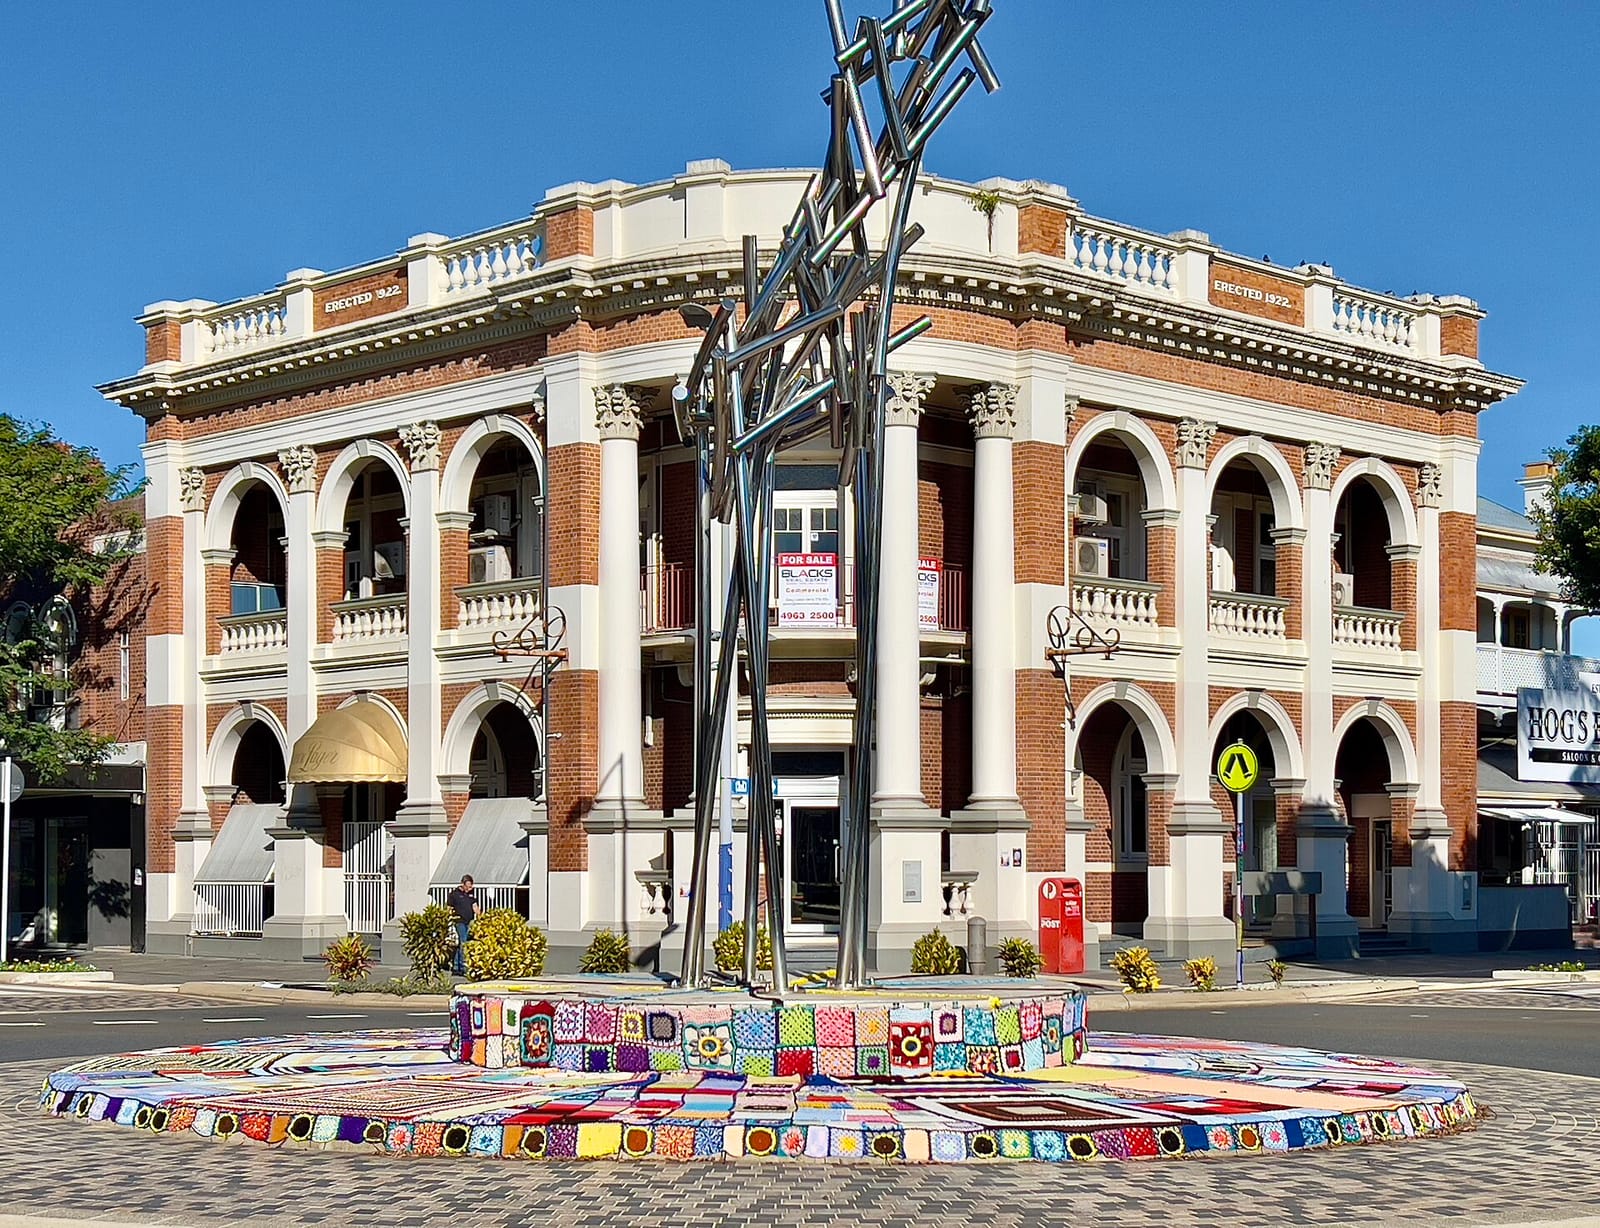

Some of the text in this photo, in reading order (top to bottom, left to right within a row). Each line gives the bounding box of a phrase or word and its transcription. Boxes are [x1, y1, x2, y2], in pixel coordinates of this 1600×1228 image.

[1214, 280, 1262, 300] ERECTED
[325, 292, 372, 312] ERECTED
[782, 555, 833, 564] FOR SALE
[781, 569, 833, 578] BLACKS
[918, 572, 937, 582] CKS
[781, 611, 834, 619] 4963 2500
[919, 614, 937, 623] 2500
[1527, 706, 1588, 744] HOG'S
[1562, 751, 1589, 763] SALOON
[1040, 919, 1060, 929] POST
